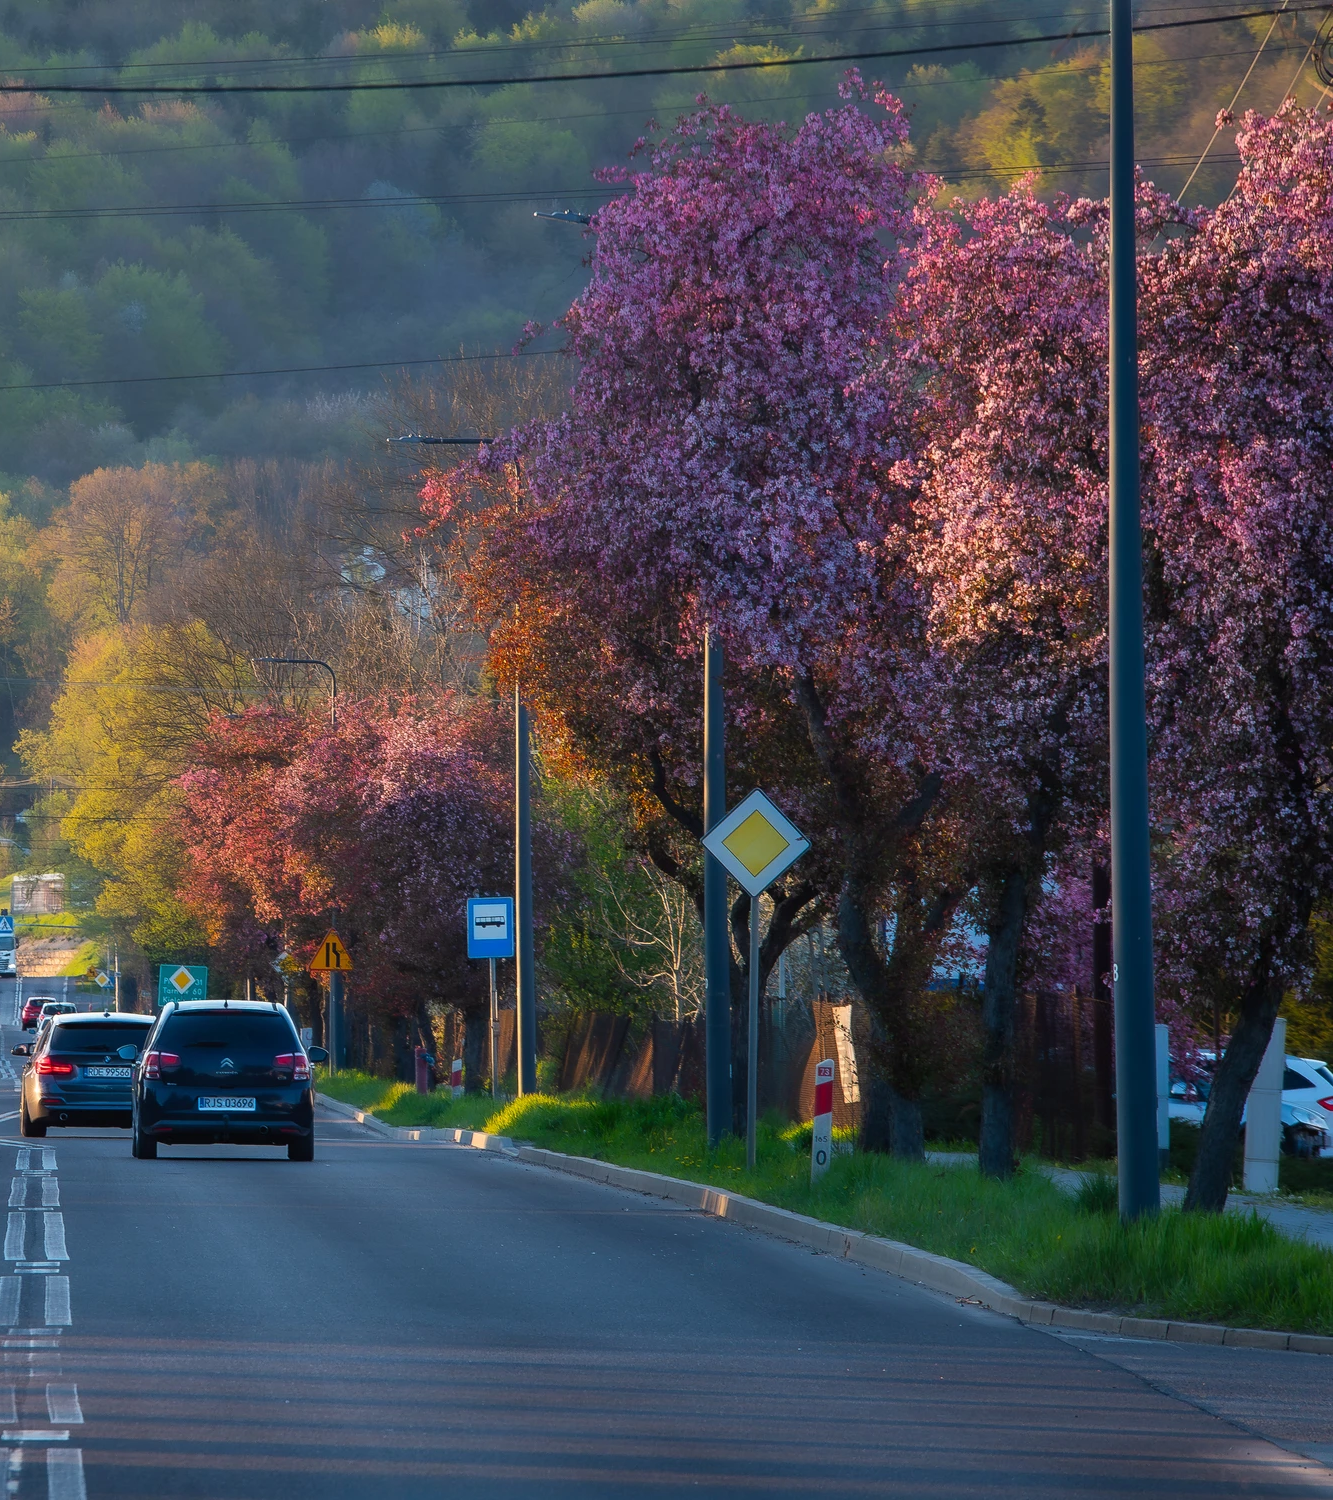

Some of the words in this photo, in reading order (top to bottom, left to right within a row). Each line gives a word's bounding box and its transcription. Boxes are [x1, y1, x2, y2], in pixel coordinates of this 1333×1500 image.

[88, 1067, 104, 1076] RDE
[106, 1068, 130, 1077] 99566
[819, 1067, 830, 1076] 73
[204, 1098, 223, 1108] RJS
[225, 1098, 254, 1108] 03696
